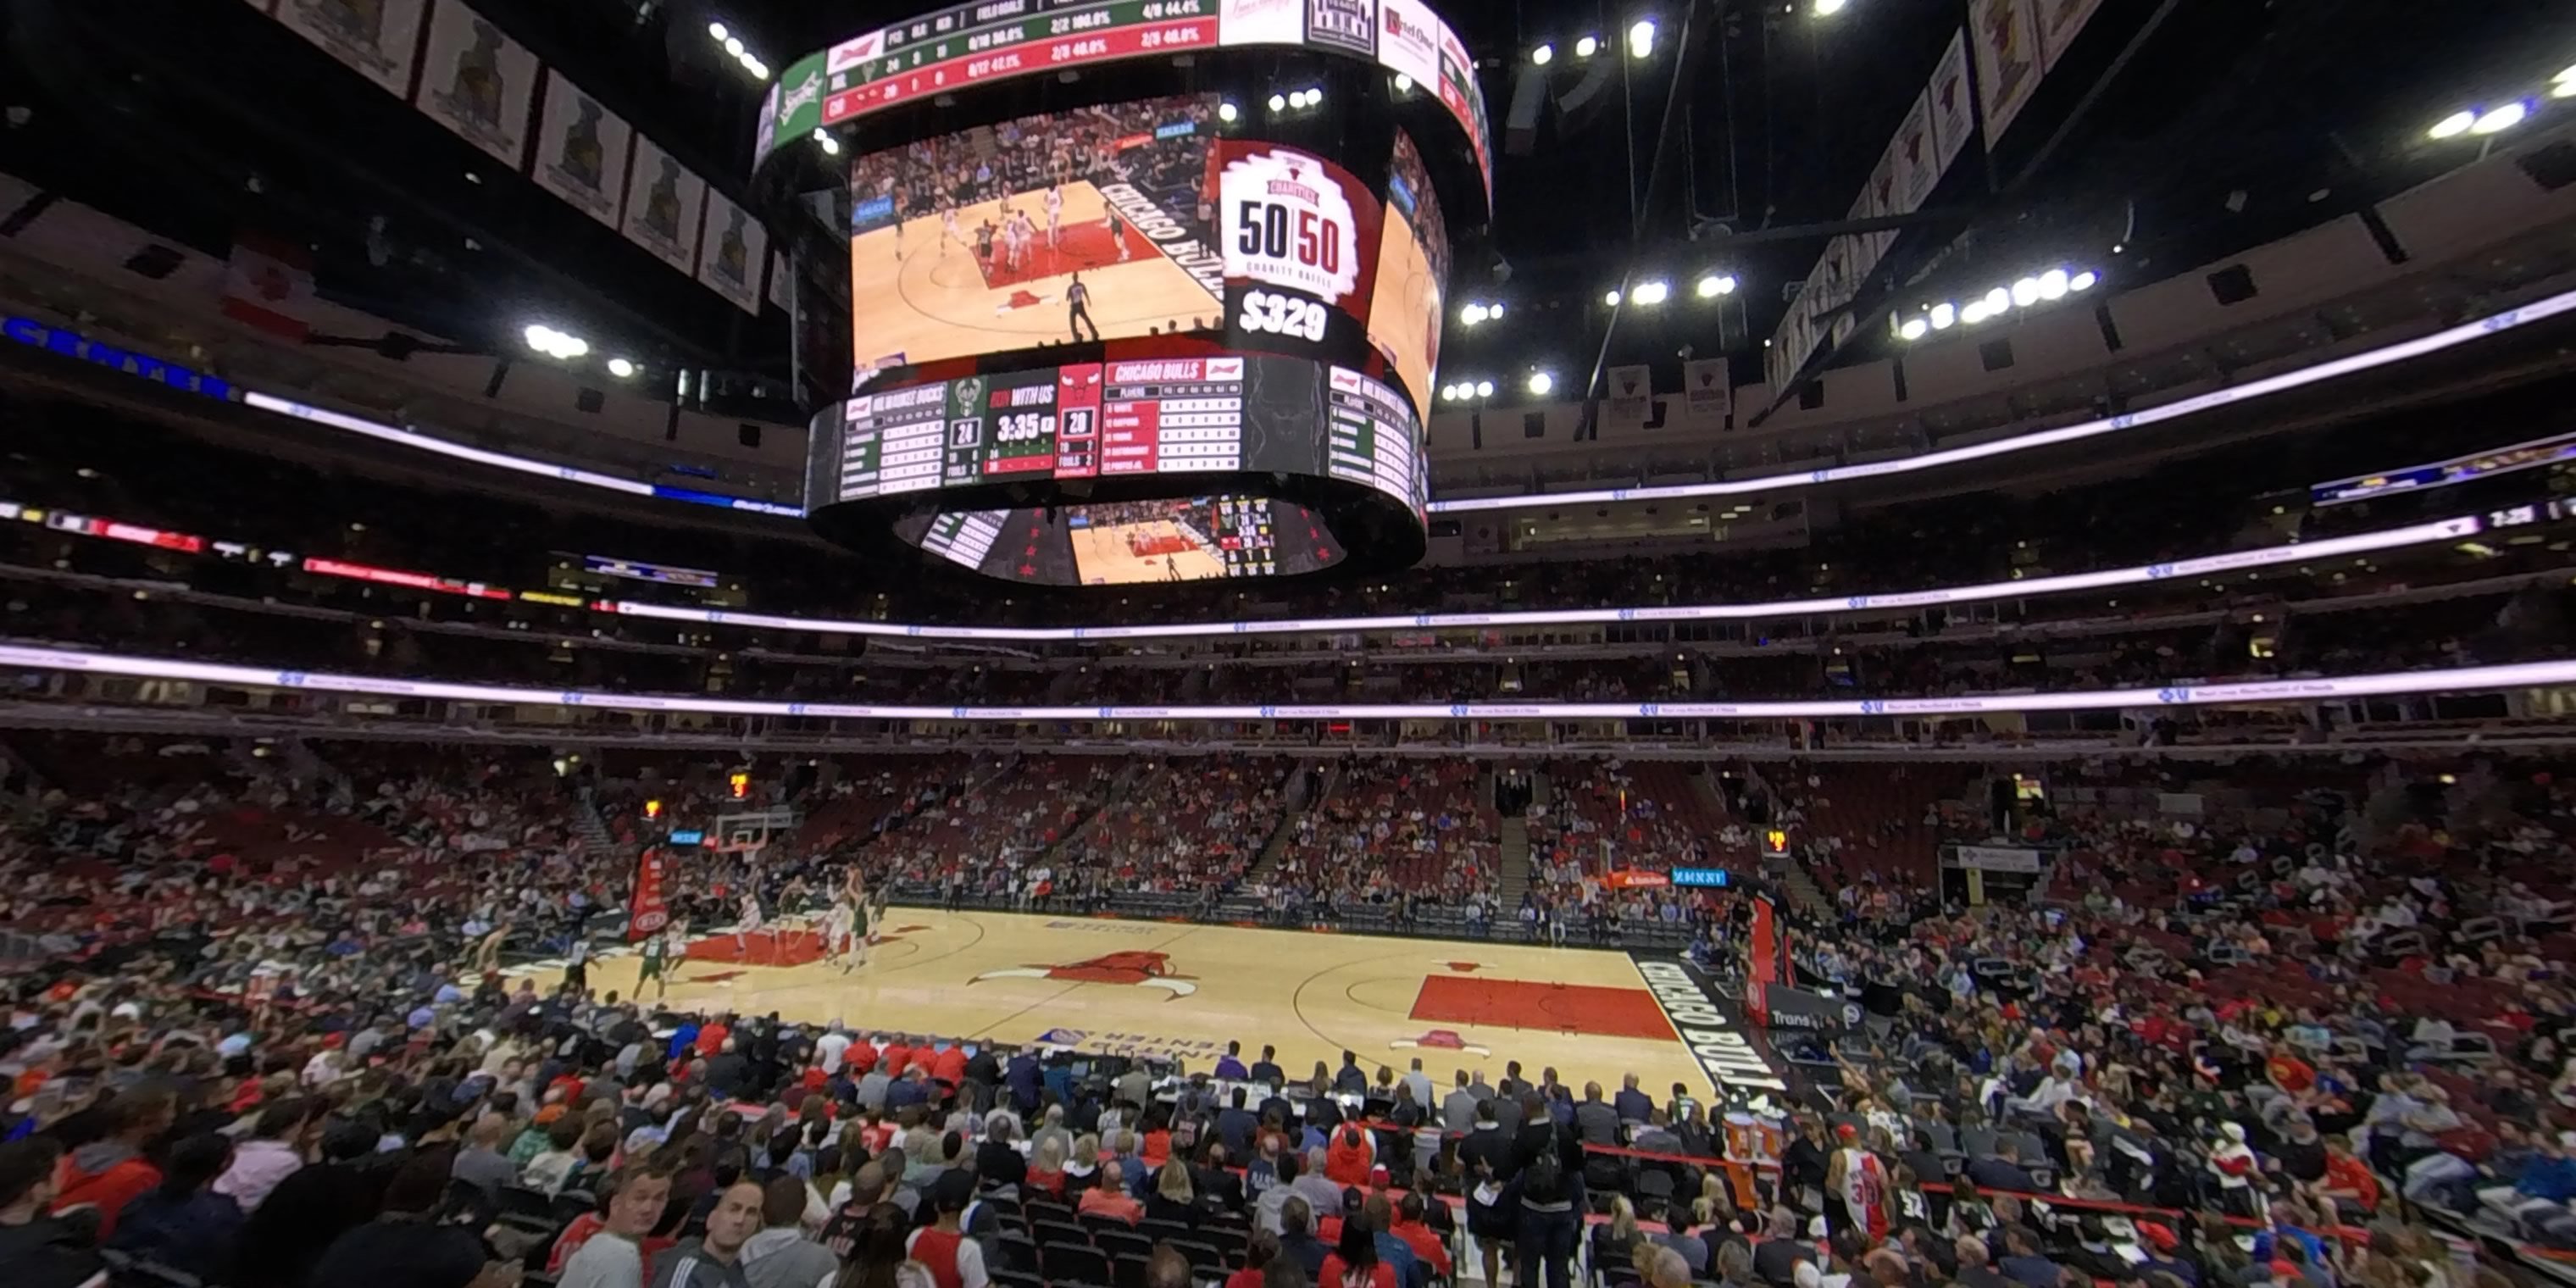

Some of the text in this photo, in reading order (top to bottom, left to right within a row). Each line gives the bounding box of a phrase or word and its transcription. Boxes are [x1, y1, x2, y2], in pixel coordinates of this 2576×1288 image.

[1239, 200, 1339, 275] 50 50
[1240, 289, 1327, 341] $329
[1114, 362, 1200, 382] CHICAGO BULLS
[1012, 387, 1038, 407] WITH
[1038, 384, 1055, 403] US
[958, 422, 974, 445] 24
[997, 413, 1039, 441] 3:35
[1069, 412, 1087, 434] 20
[1637, 961, 1727, 1026] CHICAGO
